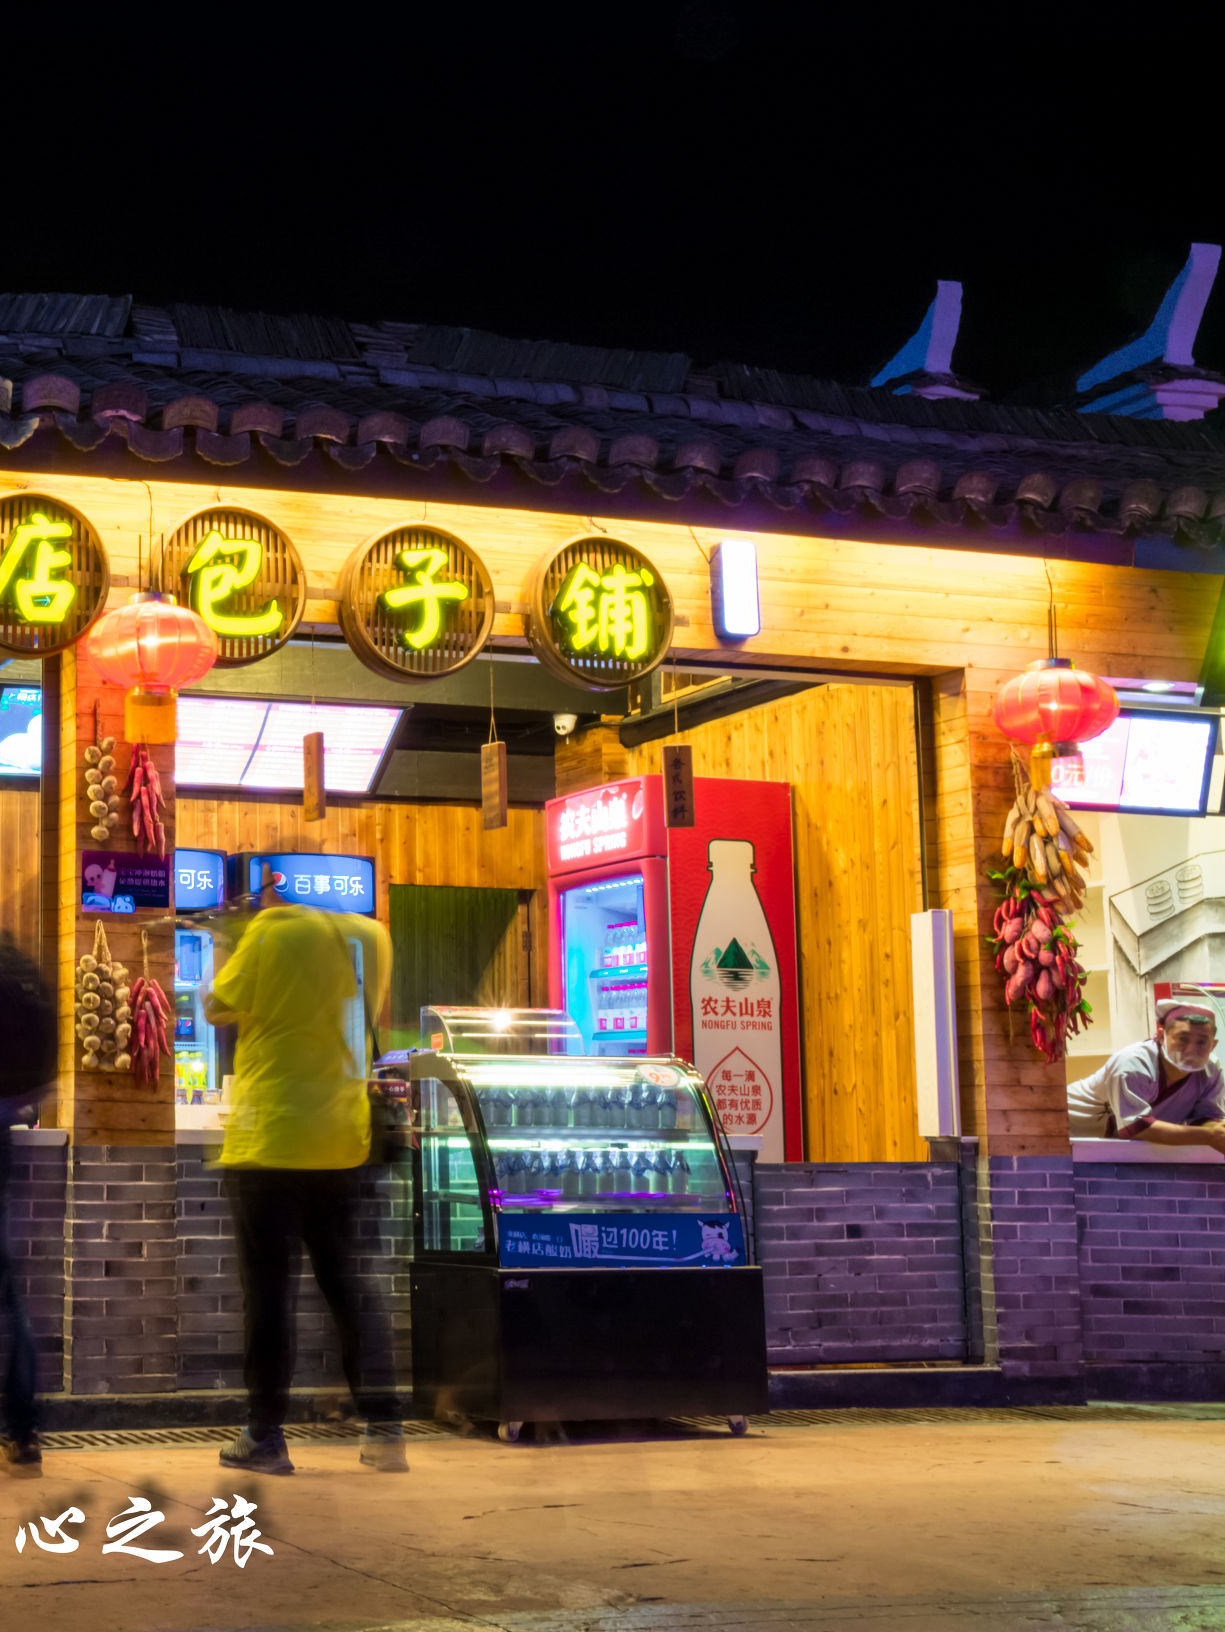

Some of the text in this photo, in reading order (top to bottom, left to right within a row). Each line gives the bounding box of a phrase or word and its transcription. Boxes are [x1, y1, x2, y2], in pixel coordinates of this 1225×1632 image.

[560, 796, 627, 842] 农夫山泉
[593, 831, 627, 854] SPRING
[175, 869, 214, 890] 可乐
[294, 873, 365, 896] 百事可乐
[700, 996, 773, 1018] 农夫山泉
[701, 1020, 773, 1031] NONGFU SPRING
[721, 1070, 756, 1082] 每一滴
[716, 1084, 762, 1097] 农夫山泉
[716, 1098, 762, 1111] 都有优质
[722, 1113, 757, 1126] 的水源
